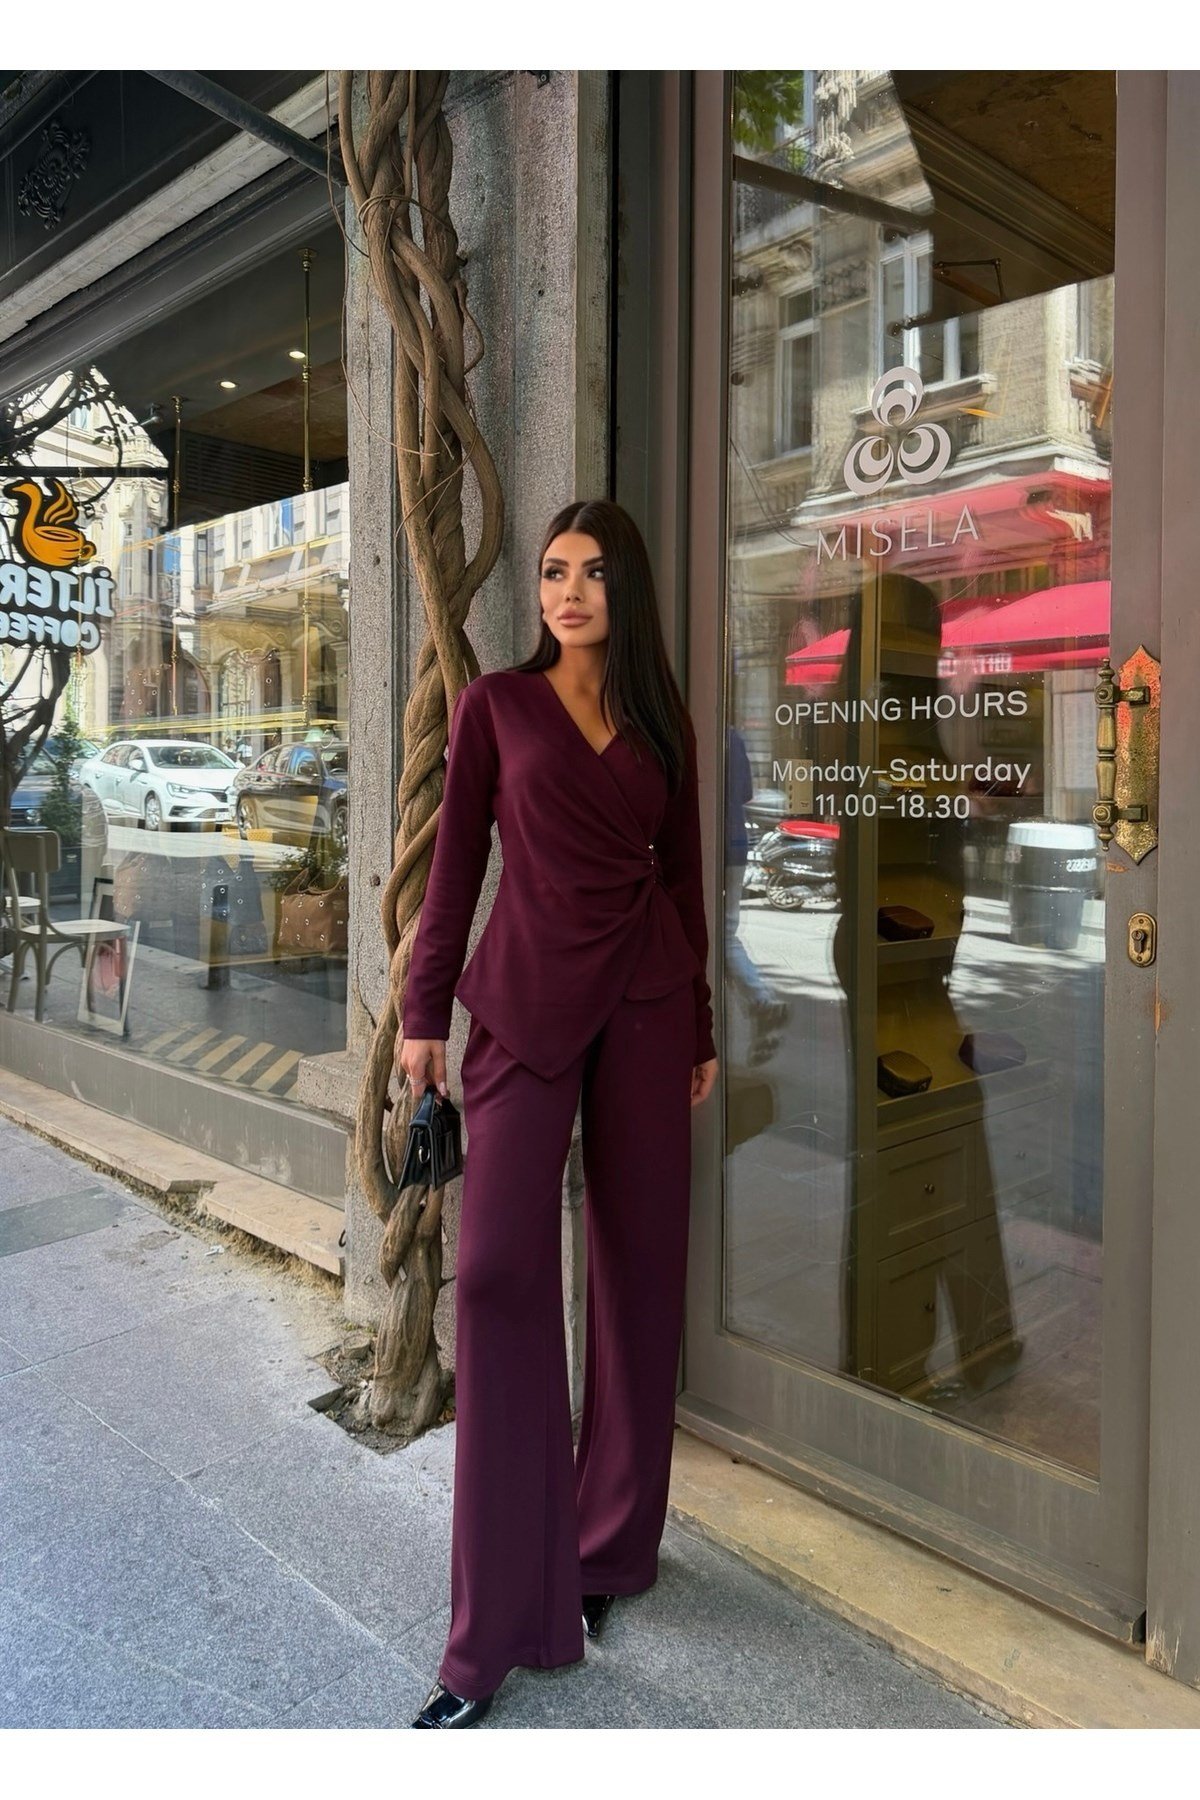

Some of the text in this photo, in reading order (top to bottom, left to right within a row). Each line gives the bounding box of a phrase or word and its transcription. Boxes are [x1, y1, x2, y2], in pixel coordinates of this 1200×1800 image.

[817, 504, 979, 565] MISELA
[775, 690, 1028, 725] OPENING HOURS
